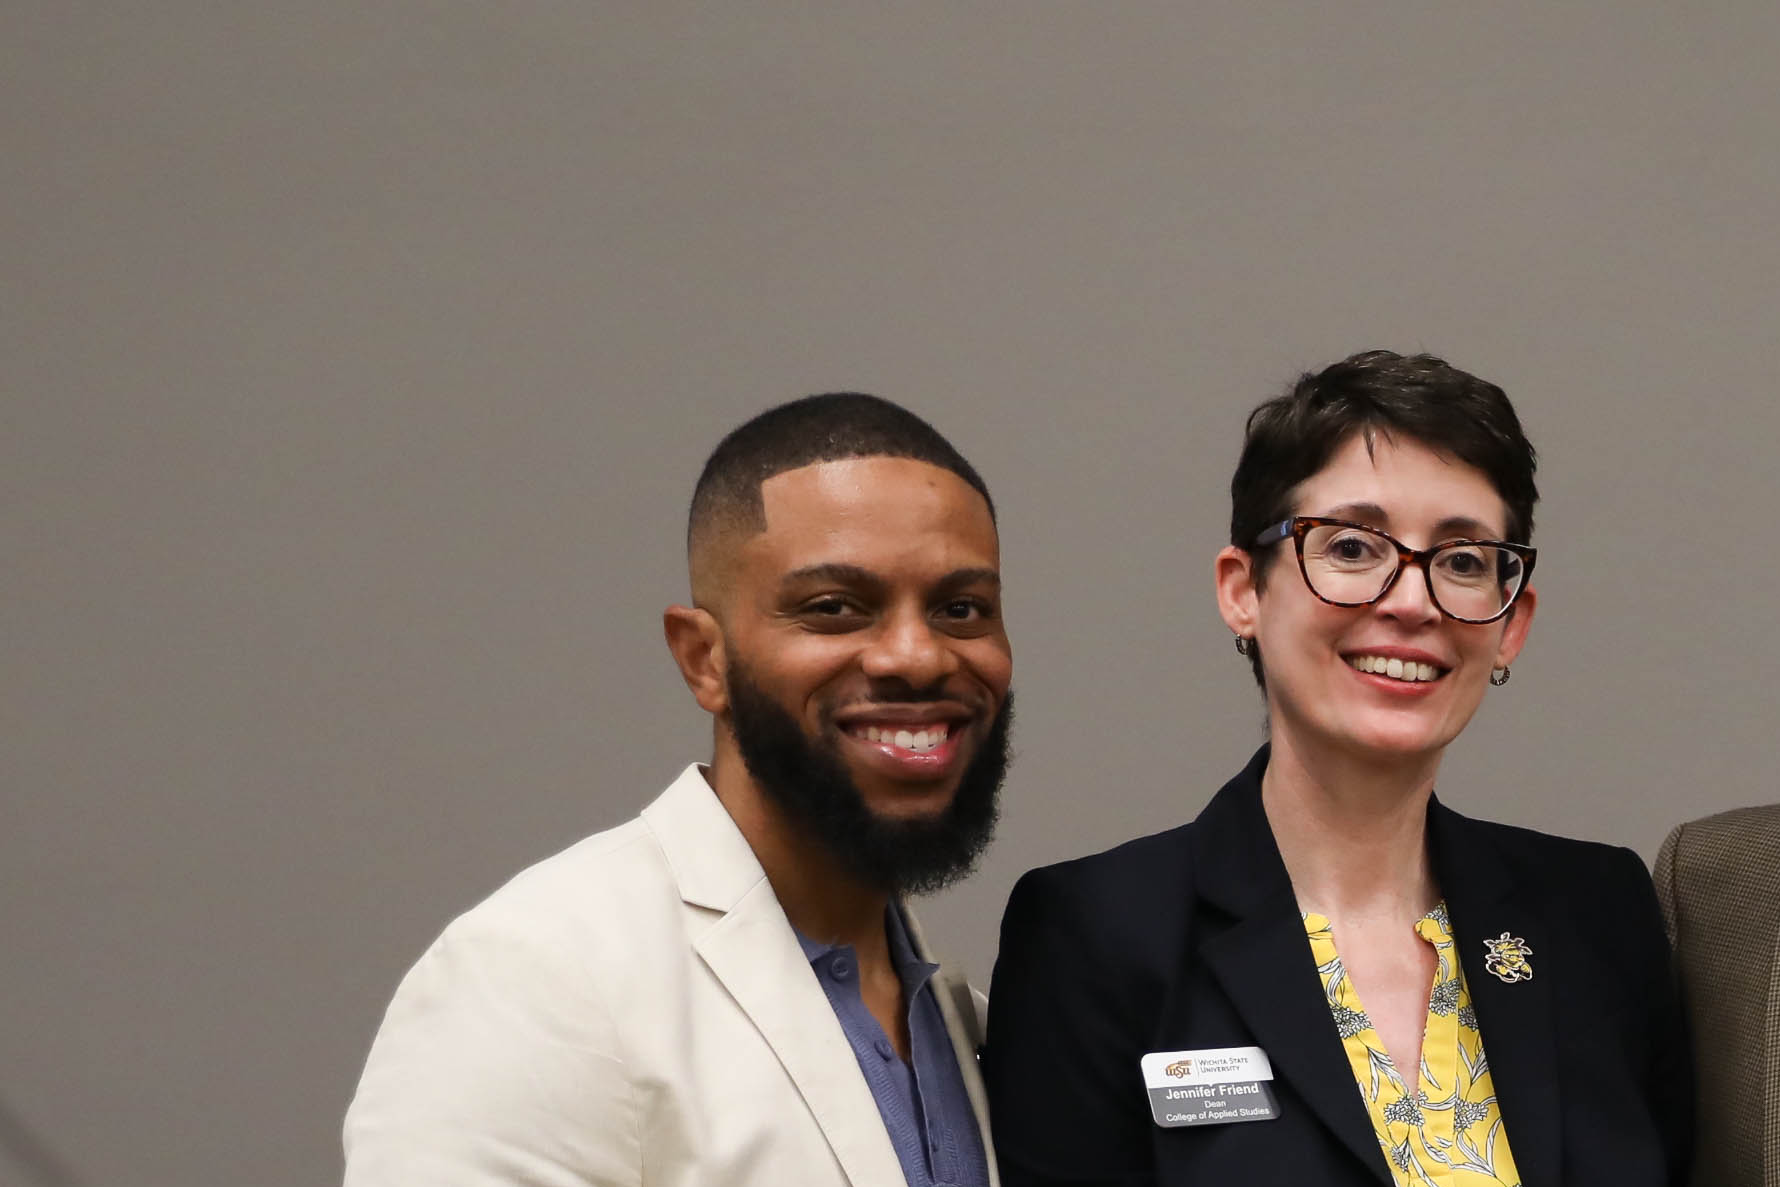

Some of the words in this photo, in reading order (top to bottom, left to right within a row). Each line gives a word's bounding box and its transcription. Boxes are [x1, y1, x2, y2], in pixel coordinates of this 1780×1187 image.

[1166, 1086, 1216, 1100] Jennifer
[1220, 1082, 1259, 1096] Friend
[1204, 1100, 1226, 1108] Dean
[1166, 1112, 1197, 1122] College
[1198, 1111, 1207, 1119] of
[1208, 1109, 1238, 1120] Applied
[1239, 1107, 1270, 1116] Studies
